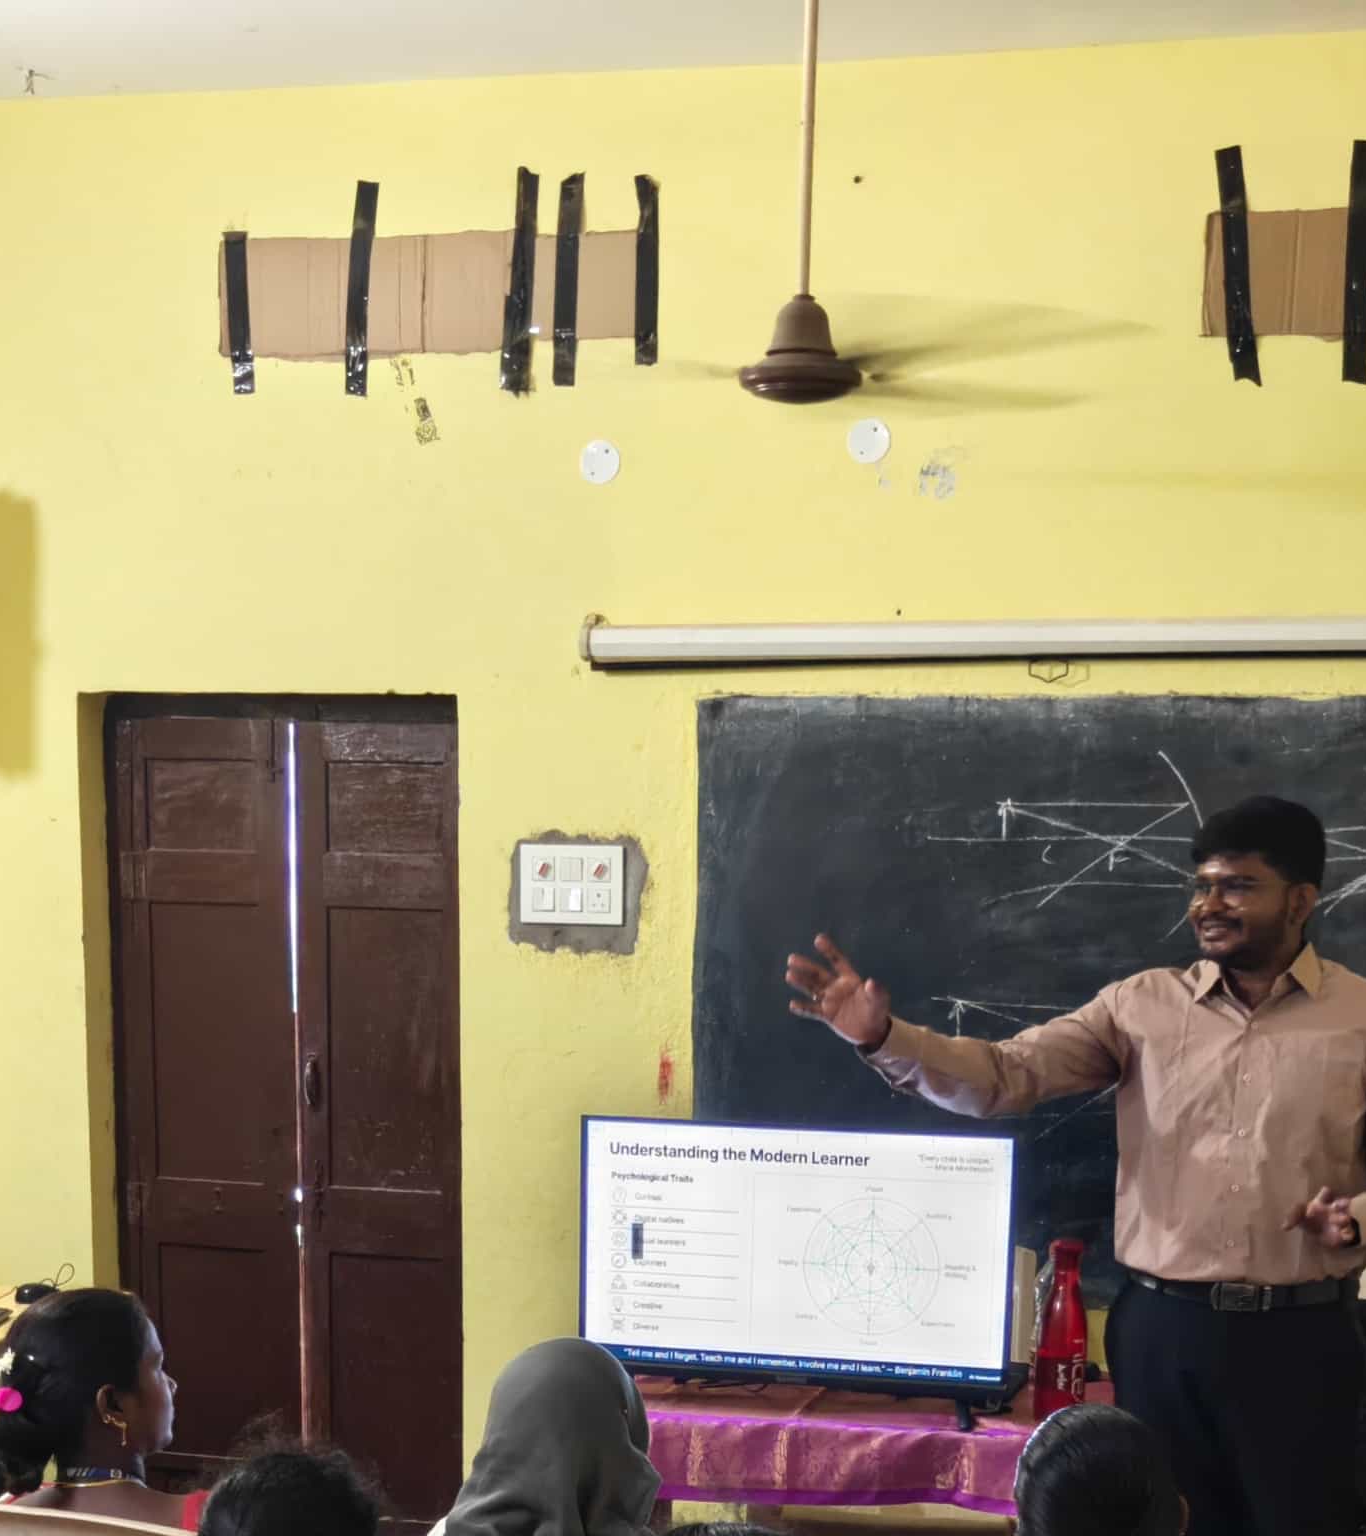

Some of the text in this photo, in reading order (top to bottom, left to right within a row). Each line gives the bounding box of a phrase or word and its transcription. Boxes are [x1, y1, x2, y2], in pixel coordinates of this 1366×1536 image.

[609, 1141, 870, 1167] Understanding the Modern Learner
[611, 1171, 669, 1184] Psychological
[642, 1350, 653, 1358] me
[654, 1350, 668, 1359] and
[724, 1355, 736, 1363] me
[737, 1356, 751, 1364] and
[827, 1362, 839, 1371] me
[840, 1362, 855, 1372] and
[895, 1365, 930, 1377] Benjamin
[931, 1367, 963, 1378] Franklin
